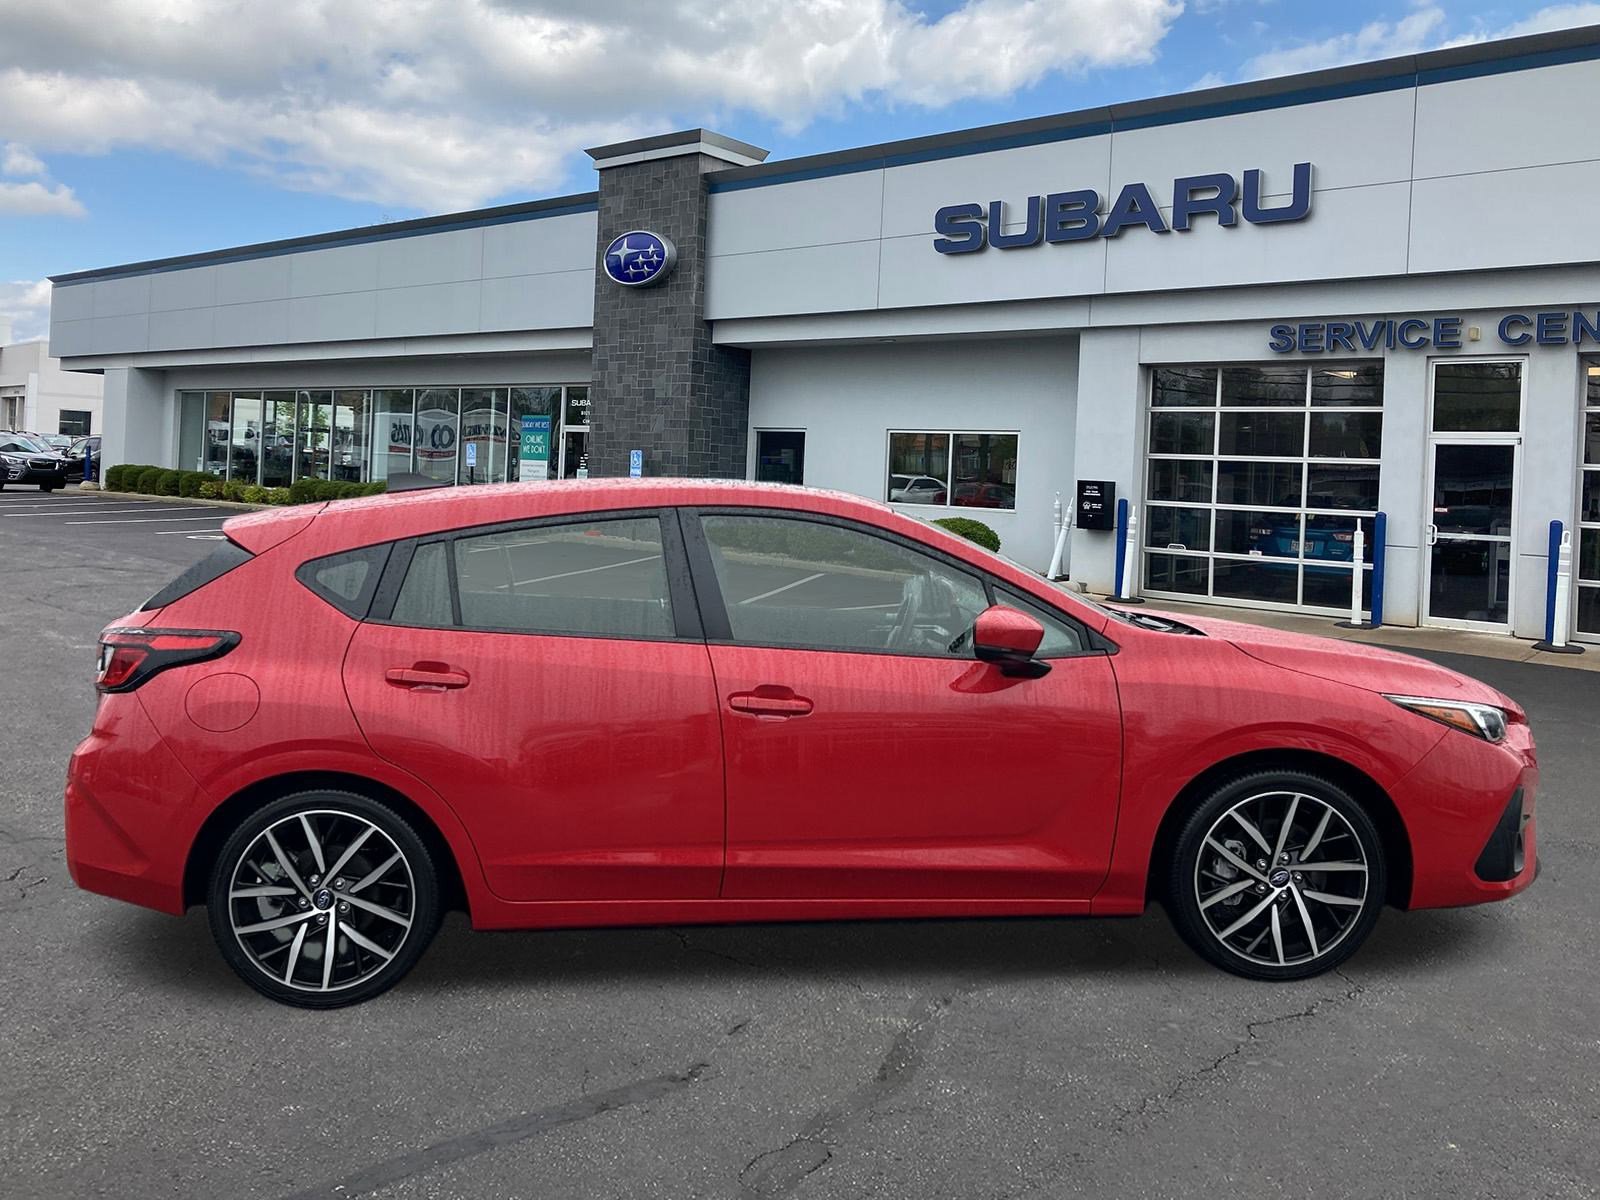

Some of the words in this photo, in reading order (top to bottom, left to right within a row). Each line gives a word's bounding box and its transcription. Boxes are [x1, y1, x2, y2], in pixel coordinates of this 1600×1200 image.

[933, 161, 1313, 255] SUBARU
[1268, 316, 1463, 353] SERVICE
[1497, 311, 1600, 346] CEN
